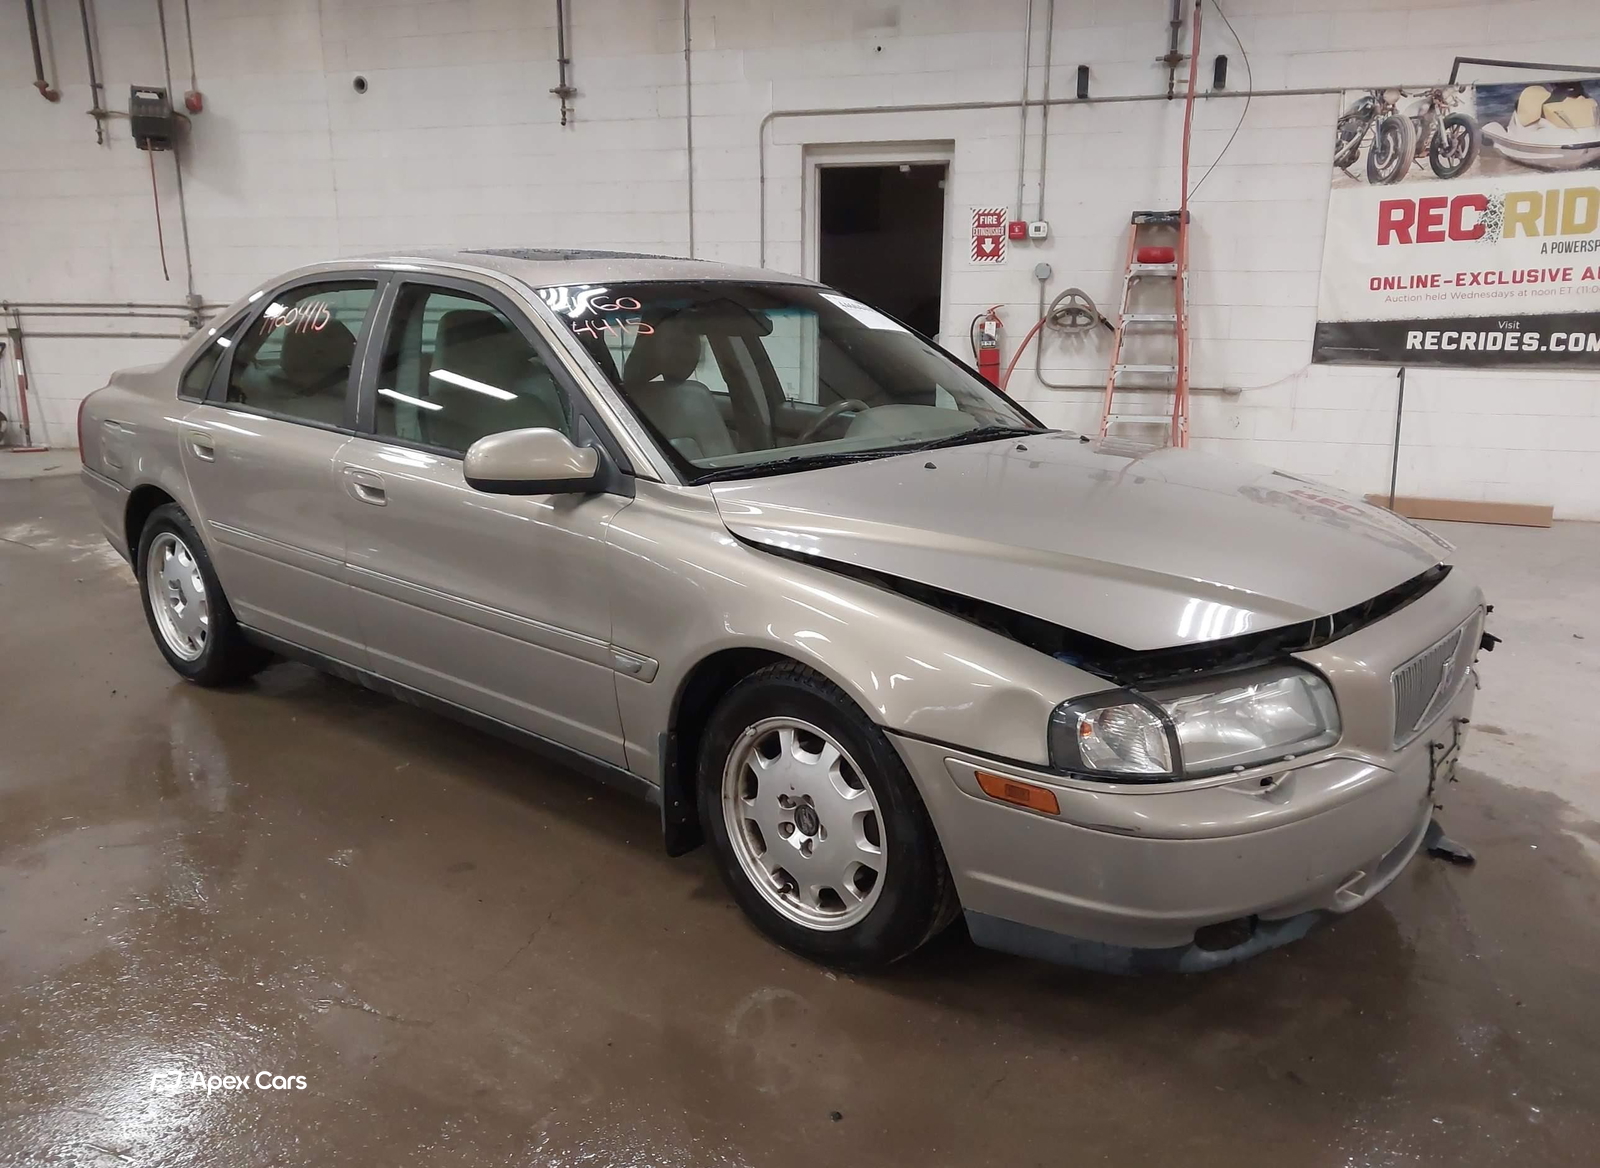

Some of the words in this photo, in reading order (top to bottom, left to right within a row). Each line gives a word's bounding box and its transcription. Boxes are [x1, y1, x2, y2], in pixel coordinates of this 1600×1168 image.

[979, 215, 998, 225] FIRE
[1376, 193, 1489, 246] REC
[1502, 186, 1600, 239] RID
[1540, 242, 1548, 255] A
[1369, 267, 1574, 291] ONLINE-EXCLUSIVE
[1581, 265, 1600, 282] A
[1384, 293, 1422, 303] Auction
[1425, 292, 1447, 301] held
[1450, 289, 1515, 300] Wednesdays
[1517, 289, 1528, 298] at
[1531, 288, 1557, 296] noon
[1559, 286, 1573, 295] ET
[1576, 286, 1600, 295] (11:0
[571, 317, 655, 339] 4415
[1498, 320, 1520, 330] Visit
[1406, 330, 1600, 351] RECRIDES.COM
